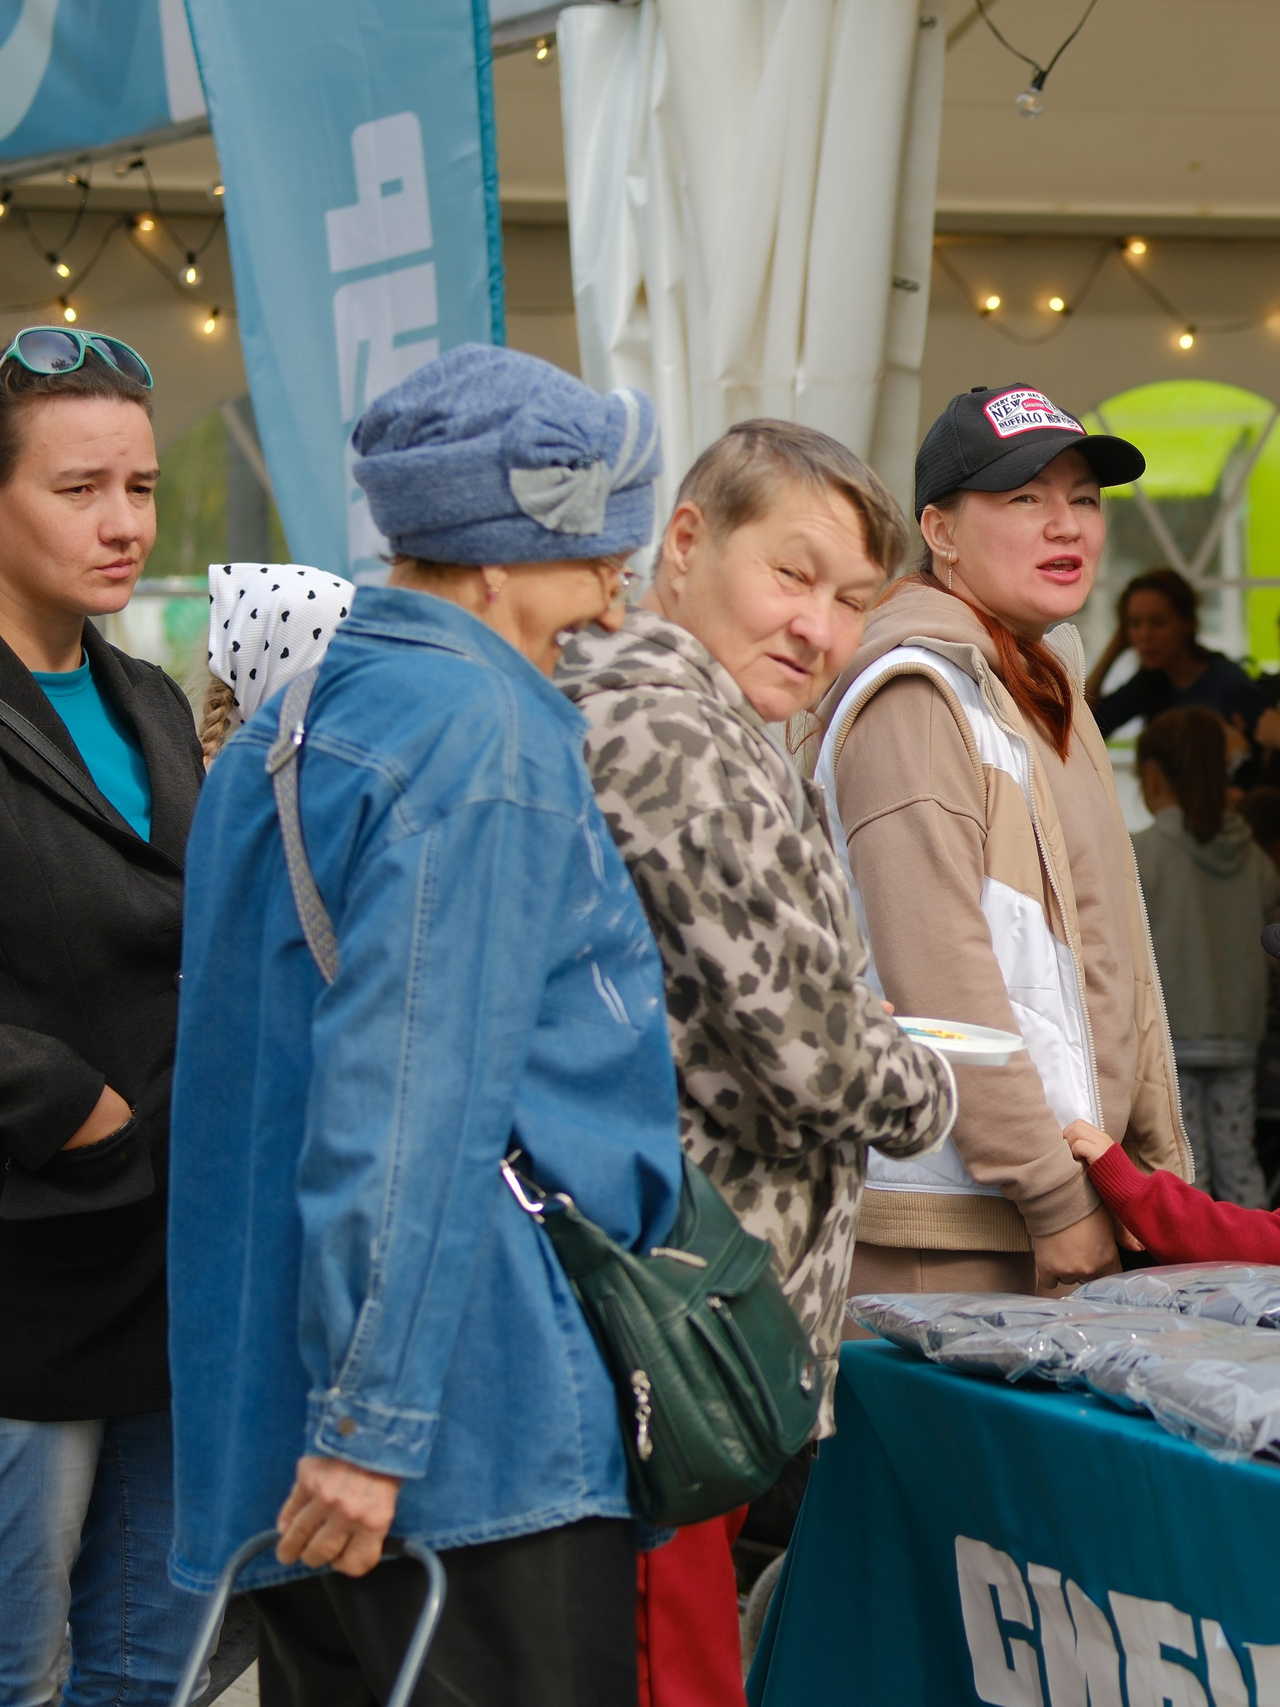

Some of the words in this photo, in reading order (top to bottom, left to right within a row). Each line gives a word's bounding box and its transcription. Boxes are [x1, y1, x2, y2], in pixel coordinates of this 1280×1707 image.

[989, 397, 1009, 411] EVERY
[1011, 392, 1025, 400] CAP
[992, 399, 1021, 422] NEW
[999, 412, 1043, 428] BUFFALO
